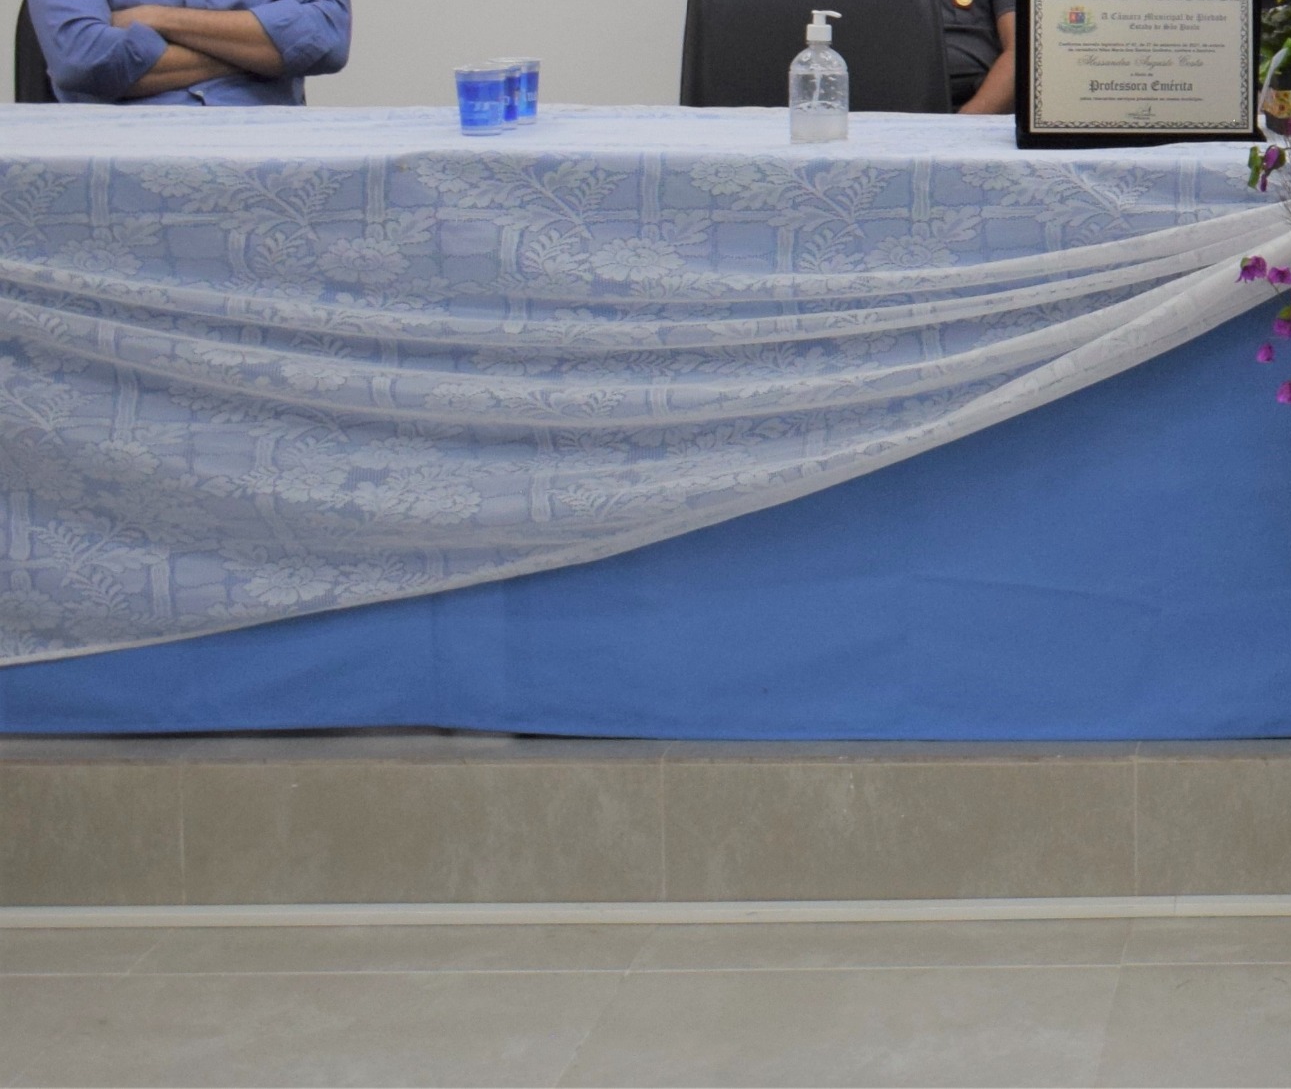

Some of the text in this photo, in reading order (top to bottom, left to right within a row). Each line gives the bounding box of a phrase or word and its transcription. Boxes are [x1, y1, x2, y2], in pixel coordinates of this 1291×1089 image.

[1143, 12, 1185, 21] Municipal
[1186, 13, 1194, 21] de
[1196, 13, 1227, 23] Piedade
[1089, 79, 1193, 92] Professora Emérita
